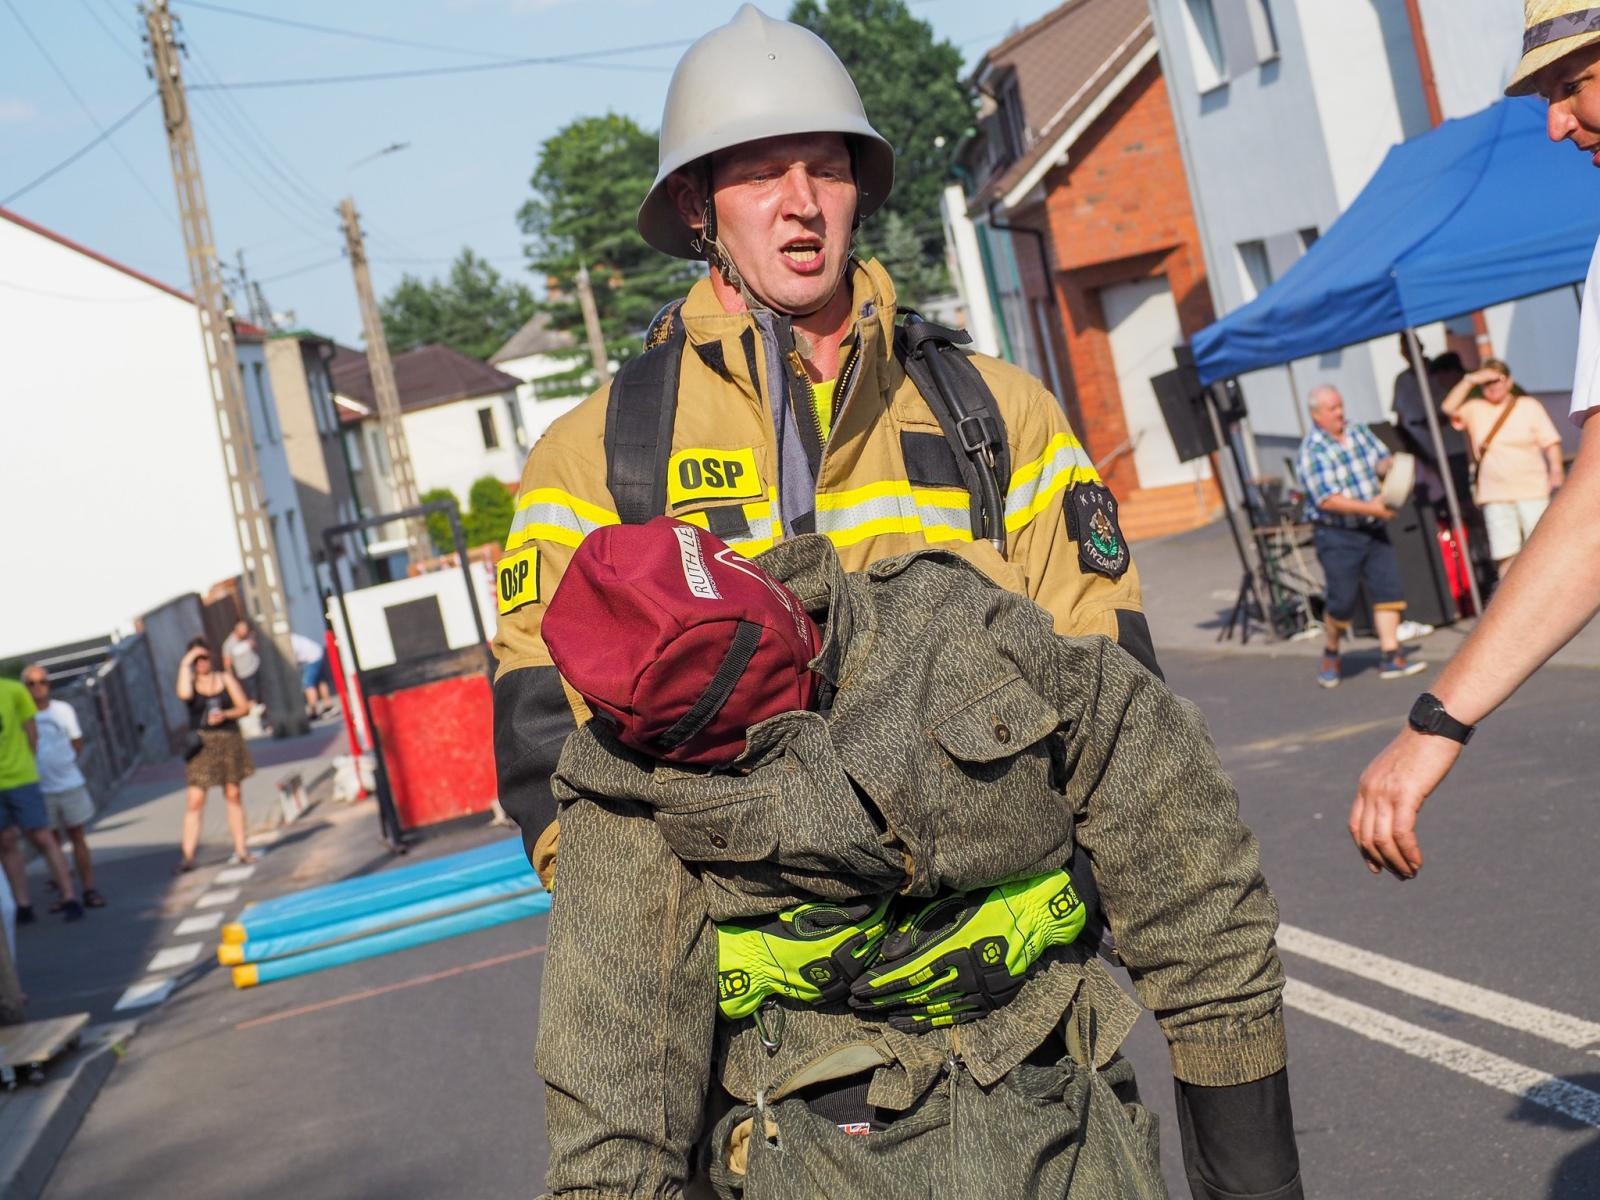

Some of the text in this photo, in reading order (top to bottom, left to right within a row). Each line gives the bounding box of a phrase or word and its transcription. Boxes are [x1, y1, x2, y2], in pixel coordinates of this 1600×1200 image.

[678, 458, 744, 490] OSP
[679, 525, 695, 548] LE
[500, 558, 529, 602] OSP
[683, 551, 710, 594] RUTH
